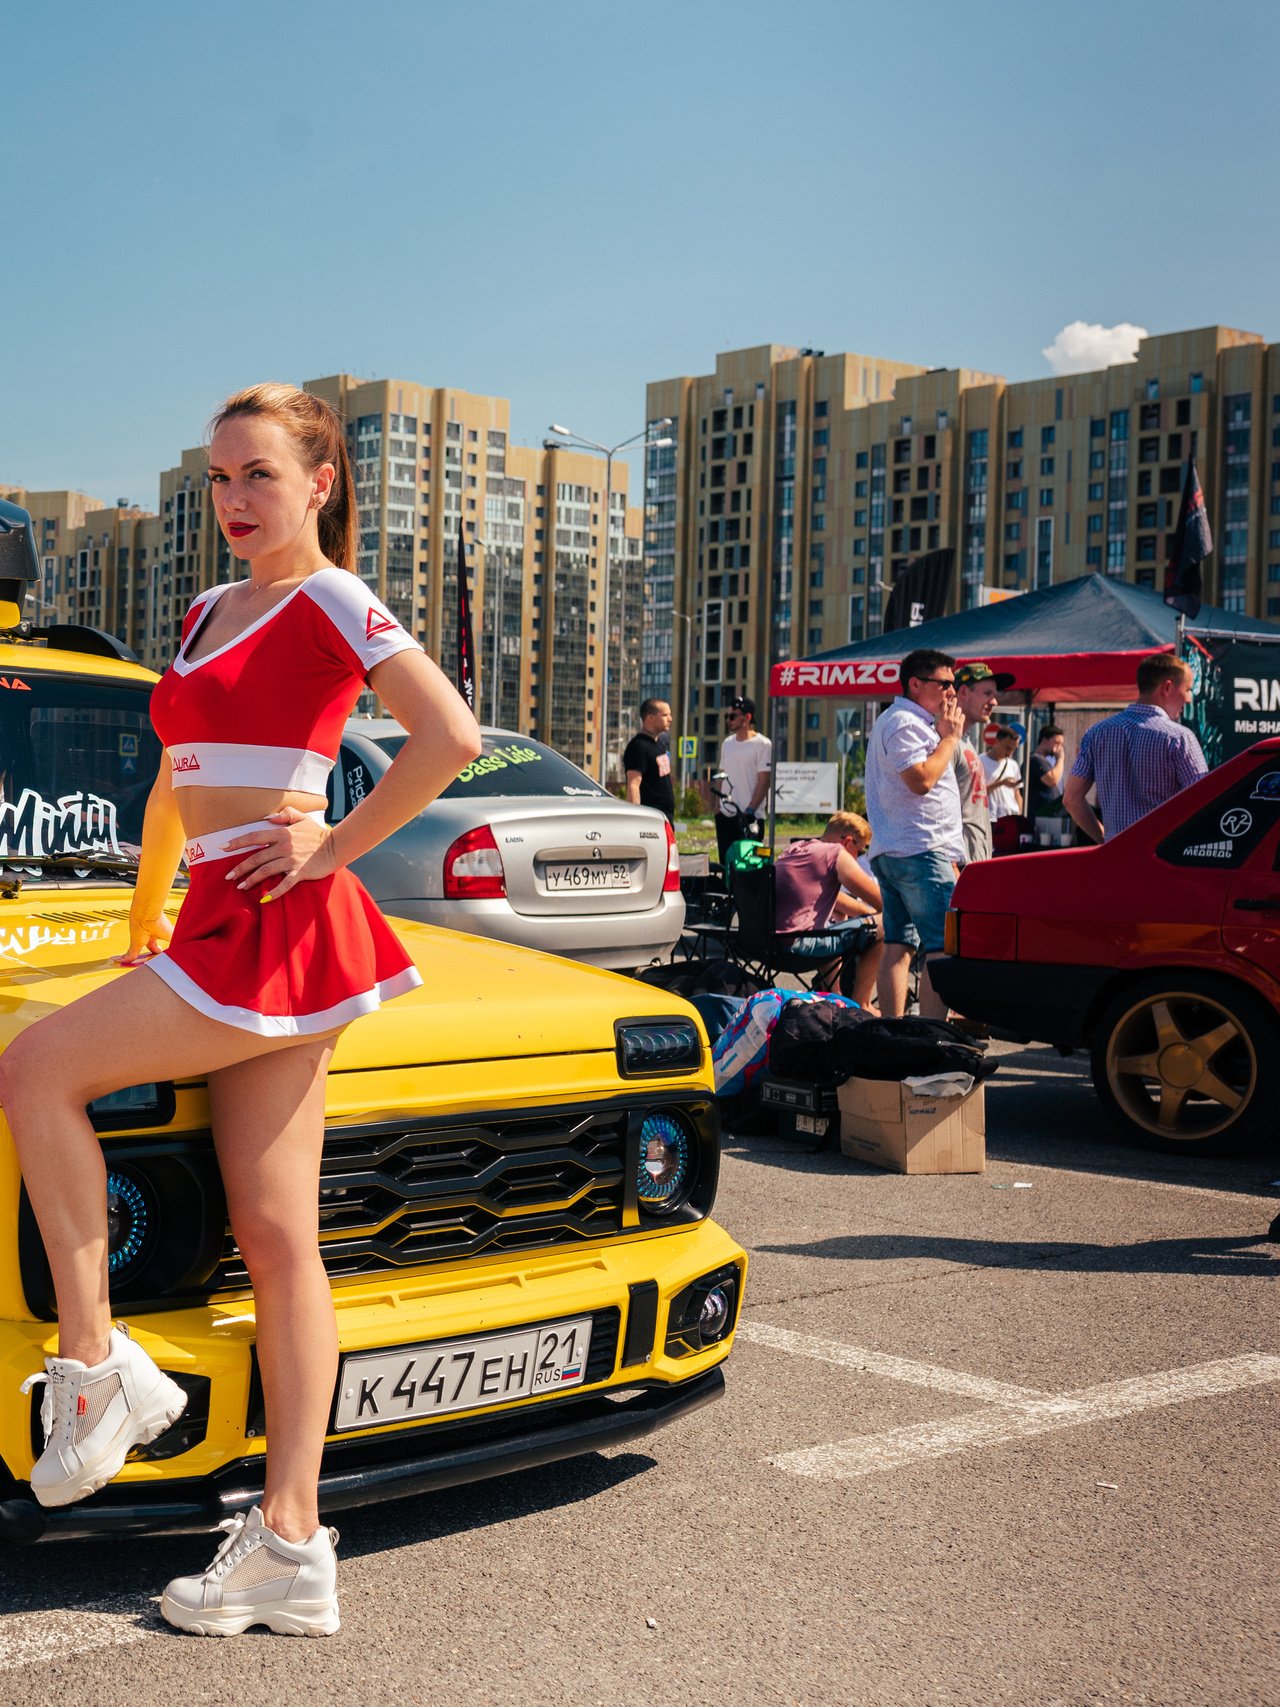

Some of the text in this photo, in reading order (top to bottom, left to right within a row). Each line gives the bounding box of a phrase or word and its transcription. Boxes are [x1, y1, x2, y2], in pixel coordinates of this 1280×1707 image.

[1234, 719, 1258, 733] МЫ
[172, 753, 201, 772] AURA
[1182, 847, 1233, 859] МЕДВЕДЬ
[613, 865, 626, 879] 52
[539, 1327, 578, 1371] 21
[534, 1367, 562, 1386] RUS
